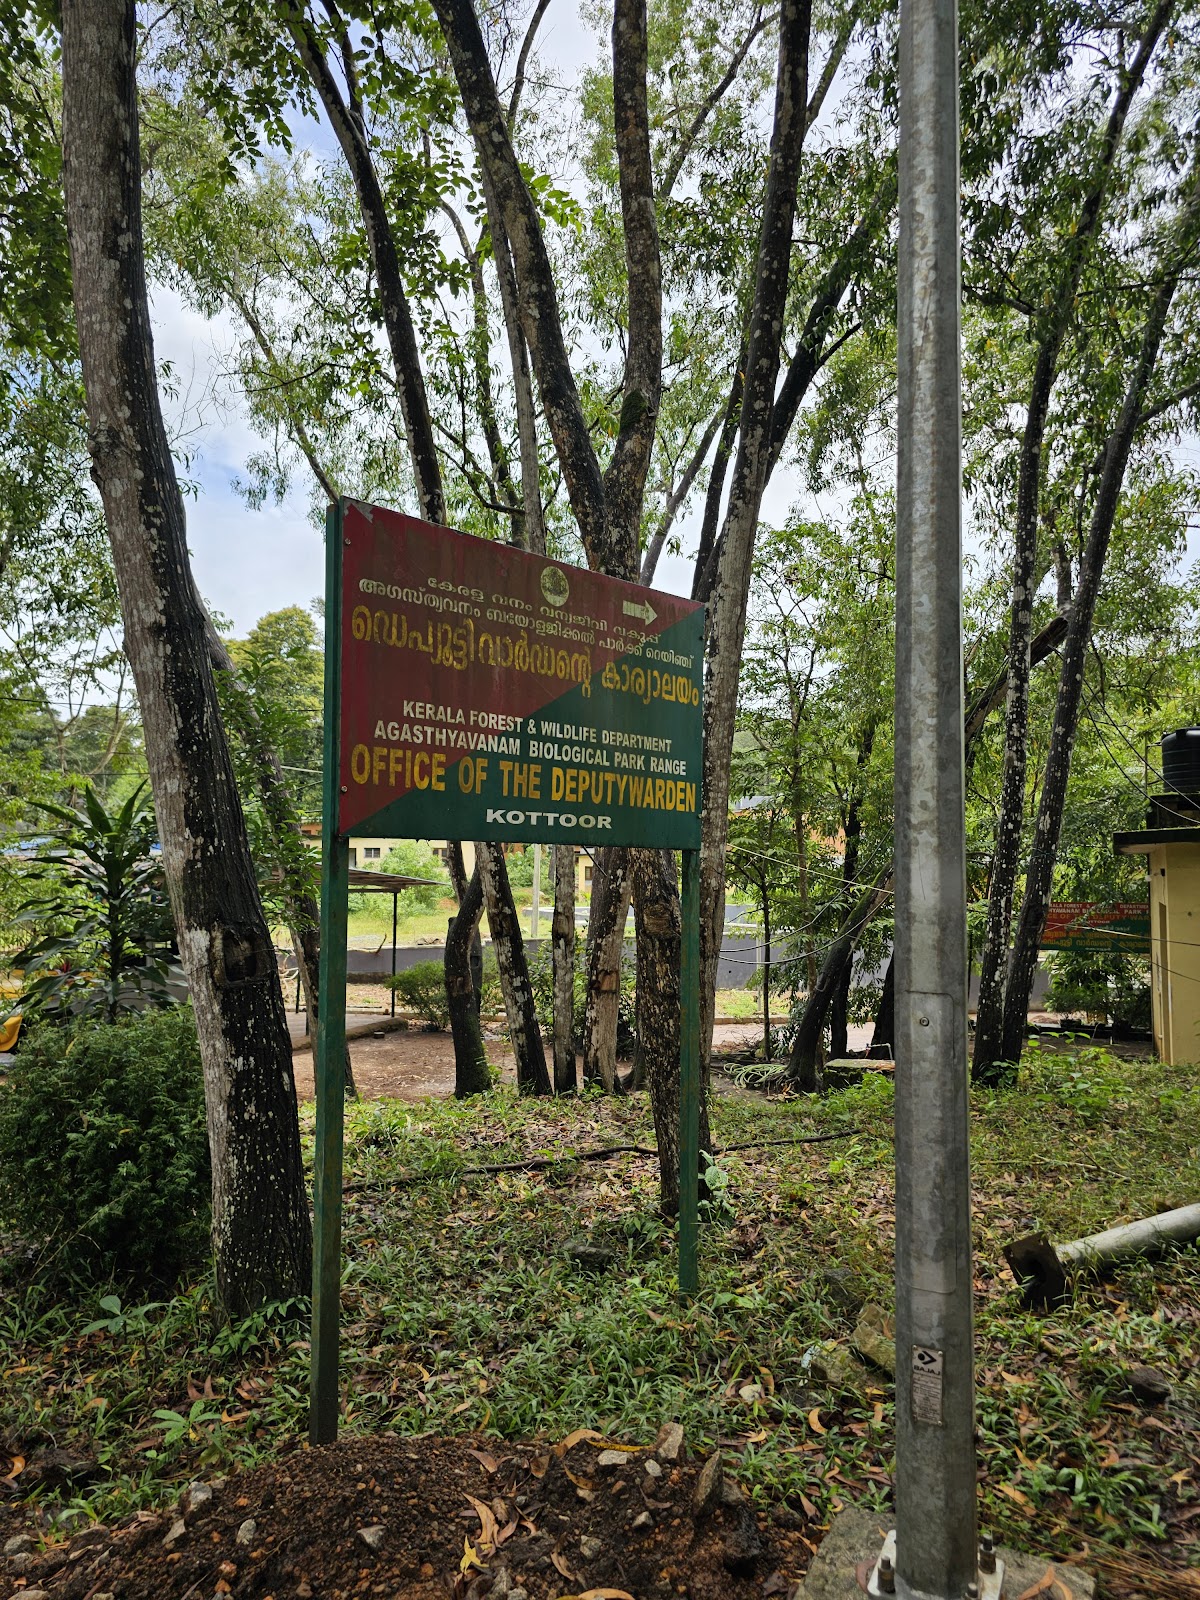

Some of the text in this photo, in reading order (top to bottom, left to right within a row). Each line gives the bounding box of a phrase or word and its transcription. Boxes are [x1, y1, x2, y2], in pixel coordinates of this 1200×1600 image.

[427, 577, 485, 602] കേരള
[492, 593, 532, 612] വനം
[540, 606, 607, 632] വന്യജീവി
[601, 661, 699, 707] കാര്യാലയം
[374, 720, 686, 776] AGASTHYAVANAM BIOLOGICAL PARK RANGE
[403, 700, 672, 753] KERALA FOREST & WILDLIFE DEPARTMENT
[351, 743, 446, 792] OFFICE
[458, 756, 488, 795] OF
[500, 760, 542, 800] THE
[486, 808, 612, 829] KOTTOOR
[913, 1365, 941, 1376] BAJAJ
